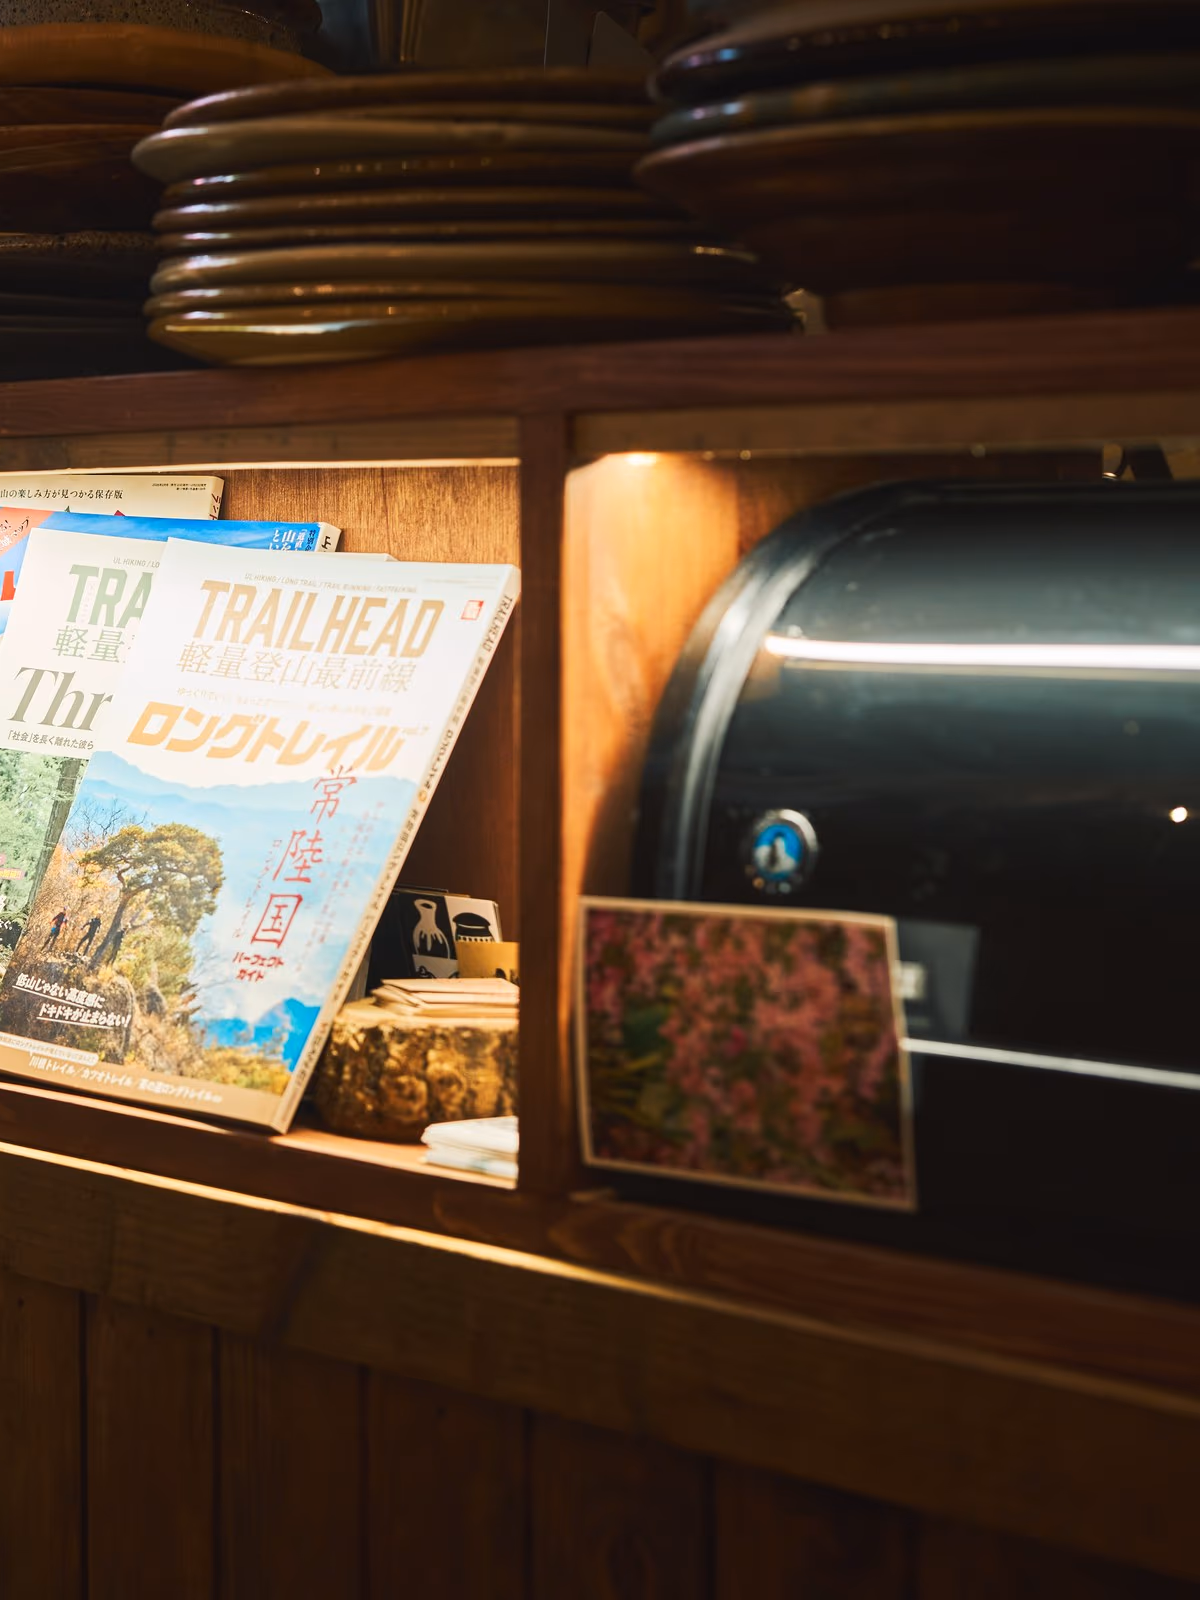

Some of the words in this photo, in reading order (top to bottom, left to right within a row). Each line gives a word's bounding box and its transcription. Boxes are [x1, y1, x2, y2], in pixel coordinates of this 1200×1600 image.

[66, 564, 154, 629] TRA
[123, 558, 147, 568] HIKING
[191, 579, 446, 659] TRAILHEAD
[176, 641, 418, 694] 軽量登山最前線
[126, 701, 406, 772] ロングトレイル
[251, 765, 358, 949] 常陸国
